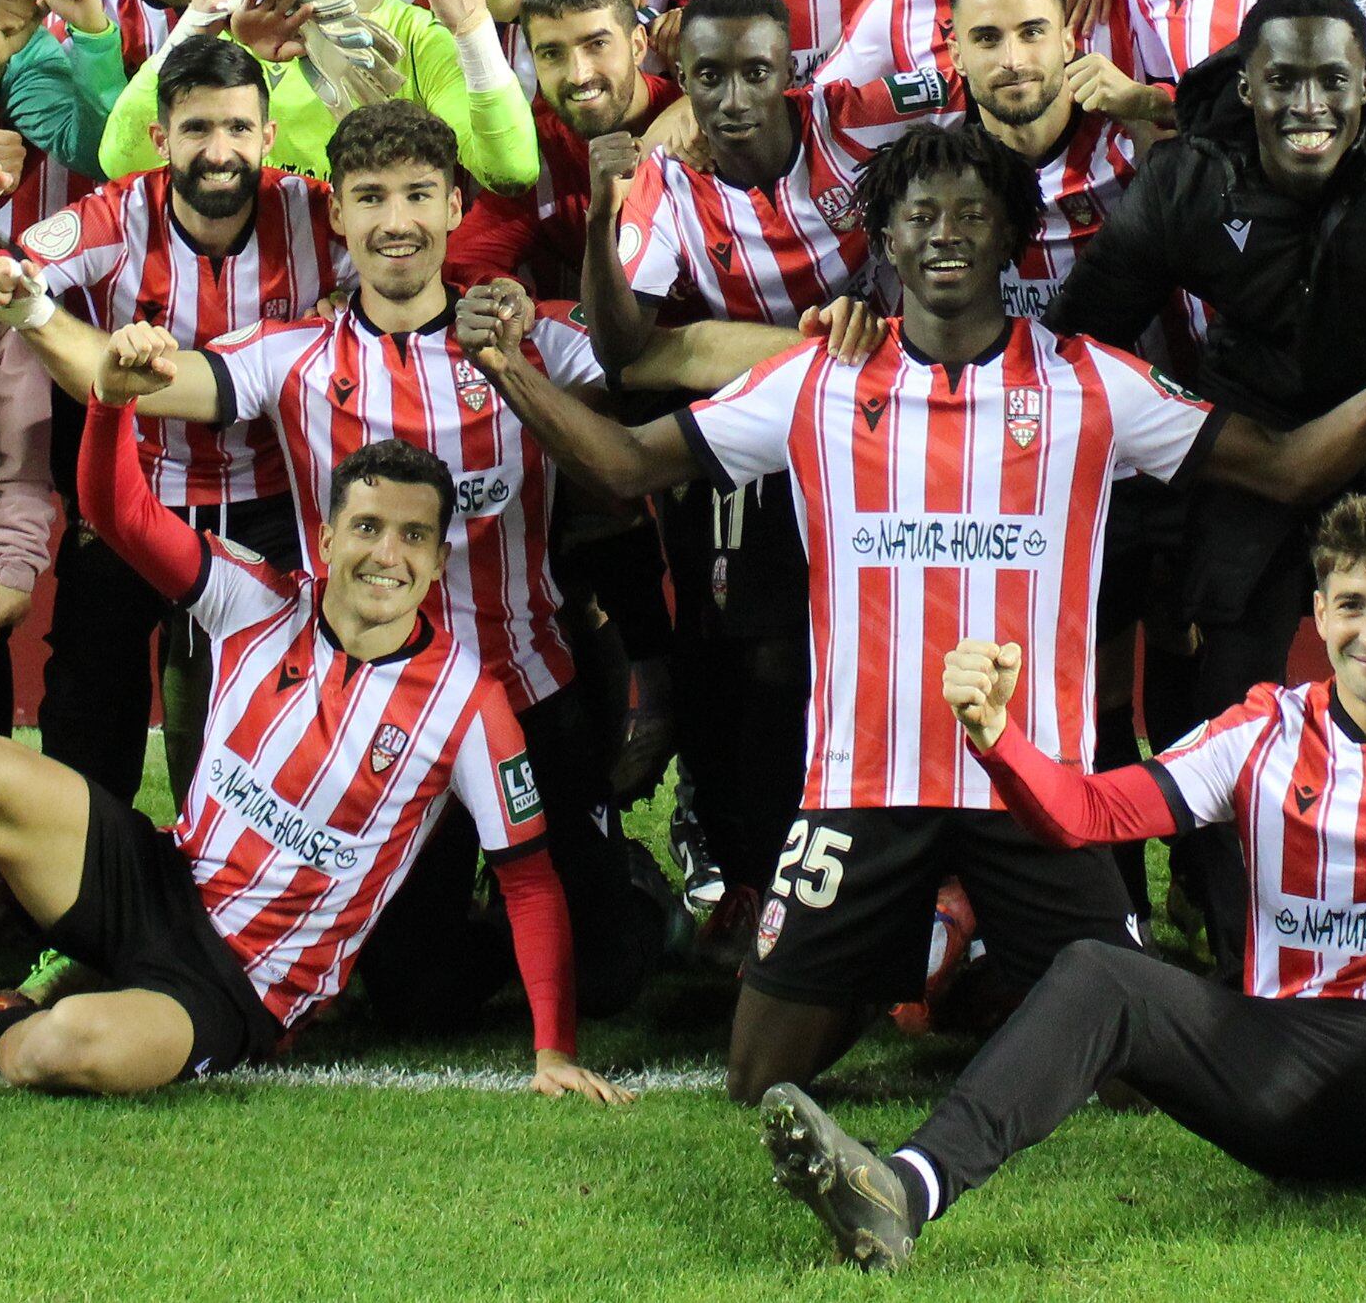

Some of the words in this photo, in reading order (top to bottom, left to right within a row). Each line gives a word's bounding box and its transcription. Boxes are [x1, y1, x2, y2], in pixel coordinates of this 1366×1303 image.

[877, 520, 946, 563] NATUR
[951, 521, 1022, 562] HOUSE
[218, 764, 274, 829] NATUR
[274, 812, 341, 867] HOUSE
[771, 818, 853, 909] 25
